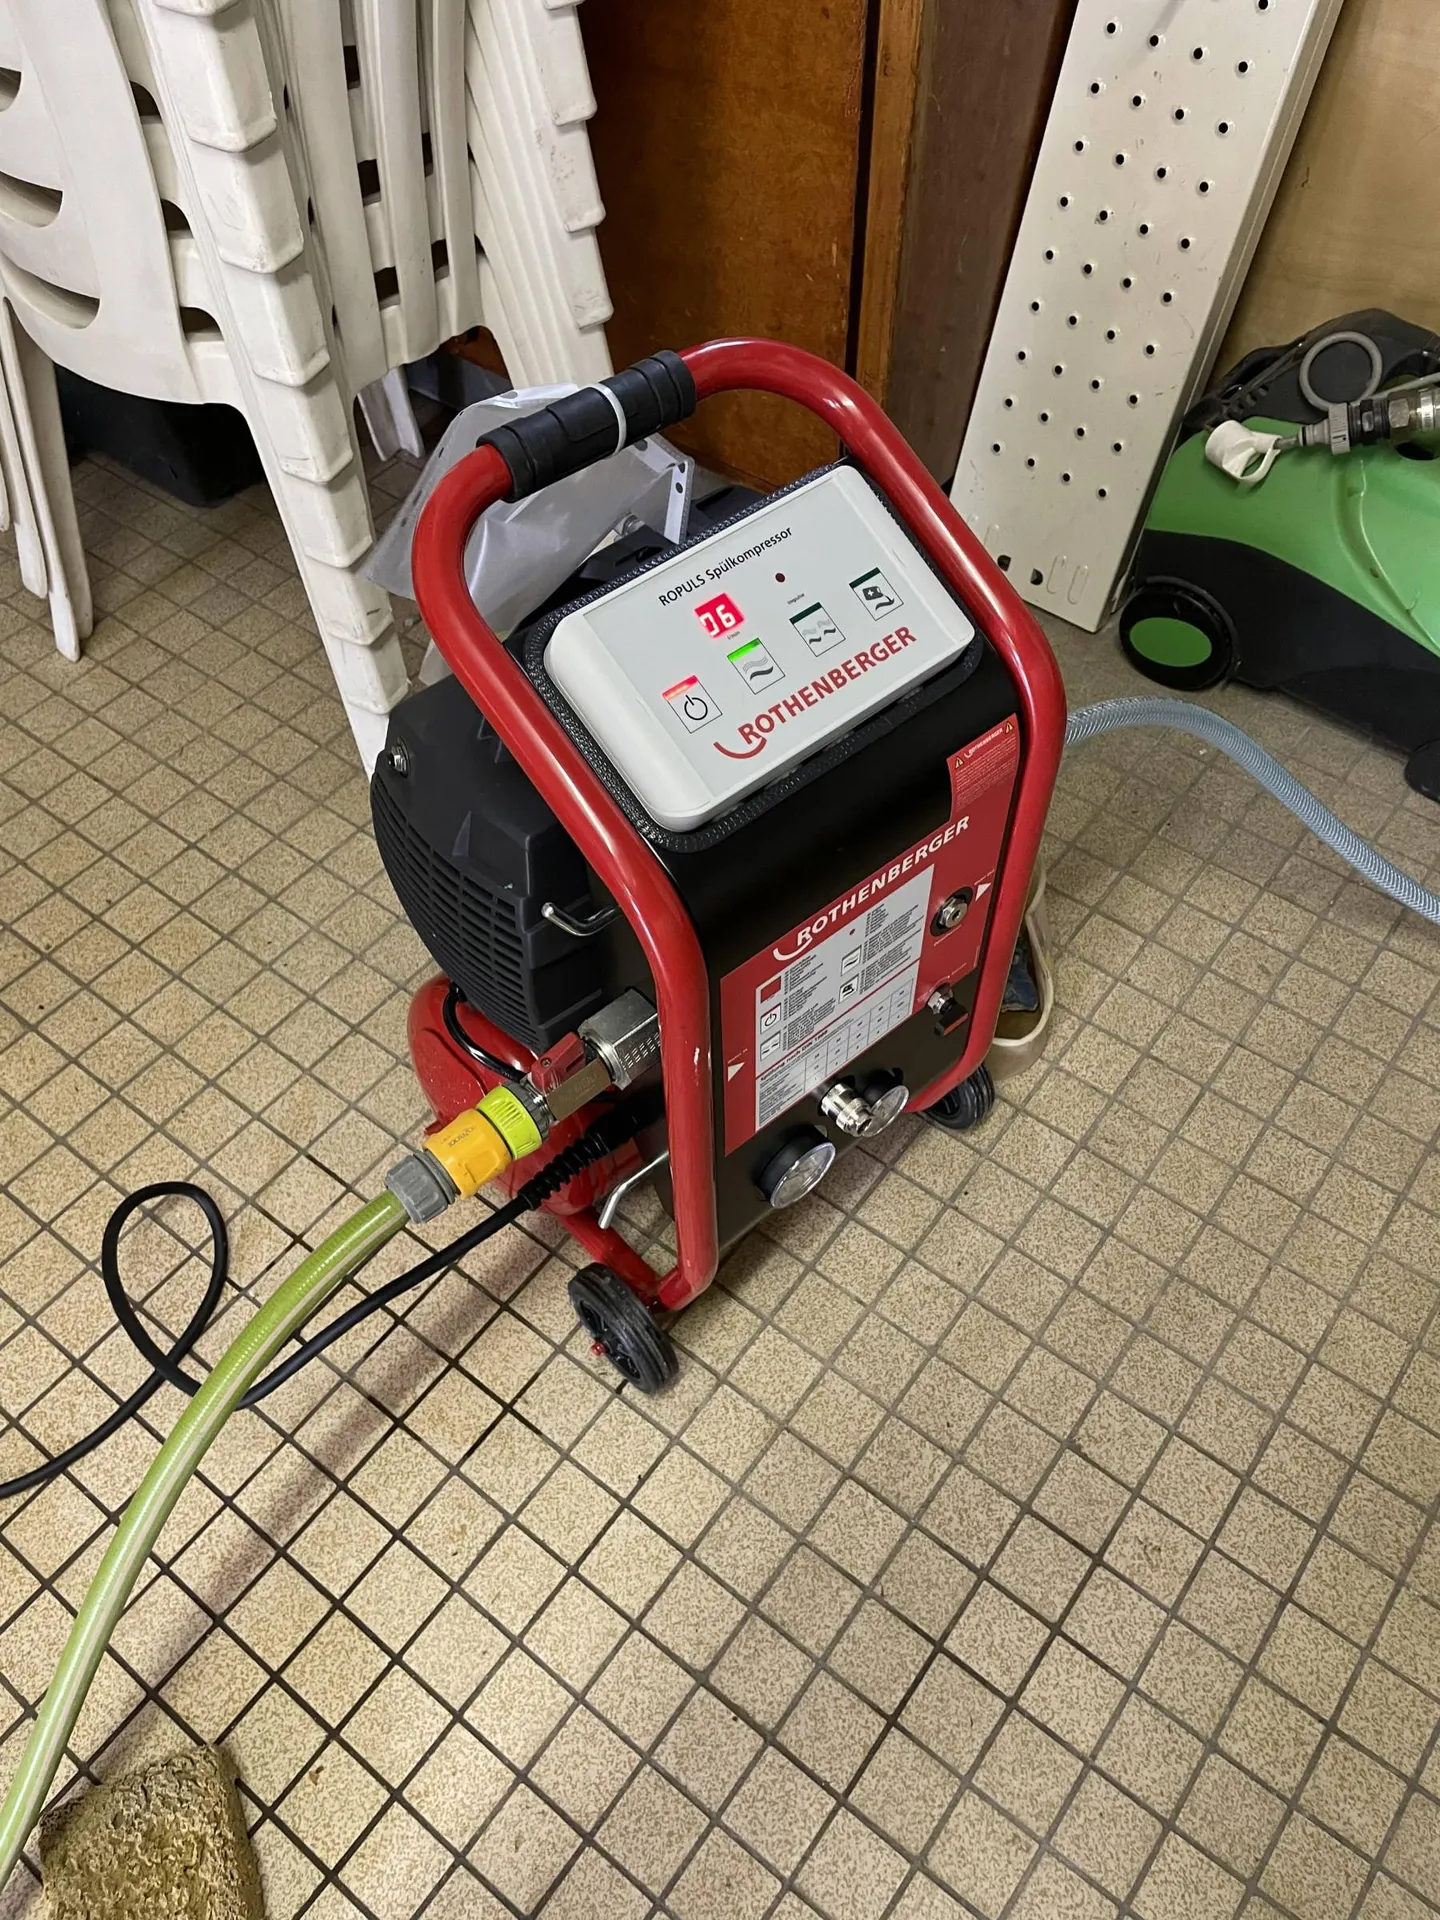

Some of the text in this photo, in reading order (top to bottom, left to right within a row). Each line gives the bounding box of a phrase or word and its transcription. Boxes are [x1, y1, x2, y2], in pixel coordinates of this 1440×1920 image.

[658, 527, 793, 607] ROPULS Spülkompressor
[736, 625, 918, 746] ROTHENBERGER
[796, 815, 970, 947] ROTHENBERGER
